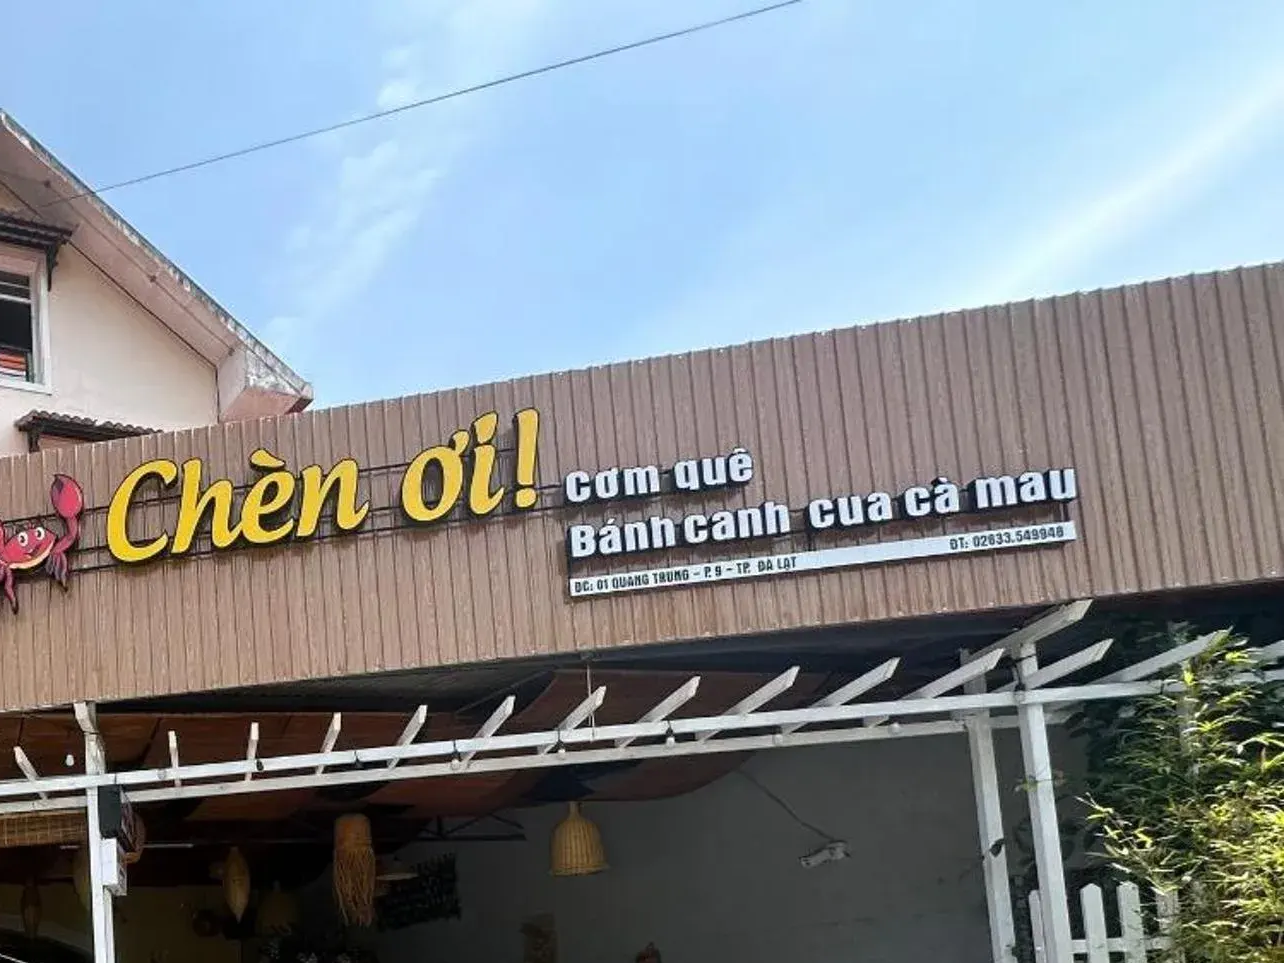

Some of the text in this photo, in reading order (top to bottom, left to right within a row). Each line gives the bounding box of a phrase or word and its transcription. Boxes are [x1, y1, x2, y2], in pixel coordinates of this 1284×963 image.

[107, 407, 541, 563] Chèn ơi!
[674, 447, 753, 490] quê
[570, 467, 1077, 558] Bánh canh cua cà mau
[597, 578, 608, 591] 01
[612, 573, 650, 590] QUANG
[652, 569, 690, 585] TRUNG
